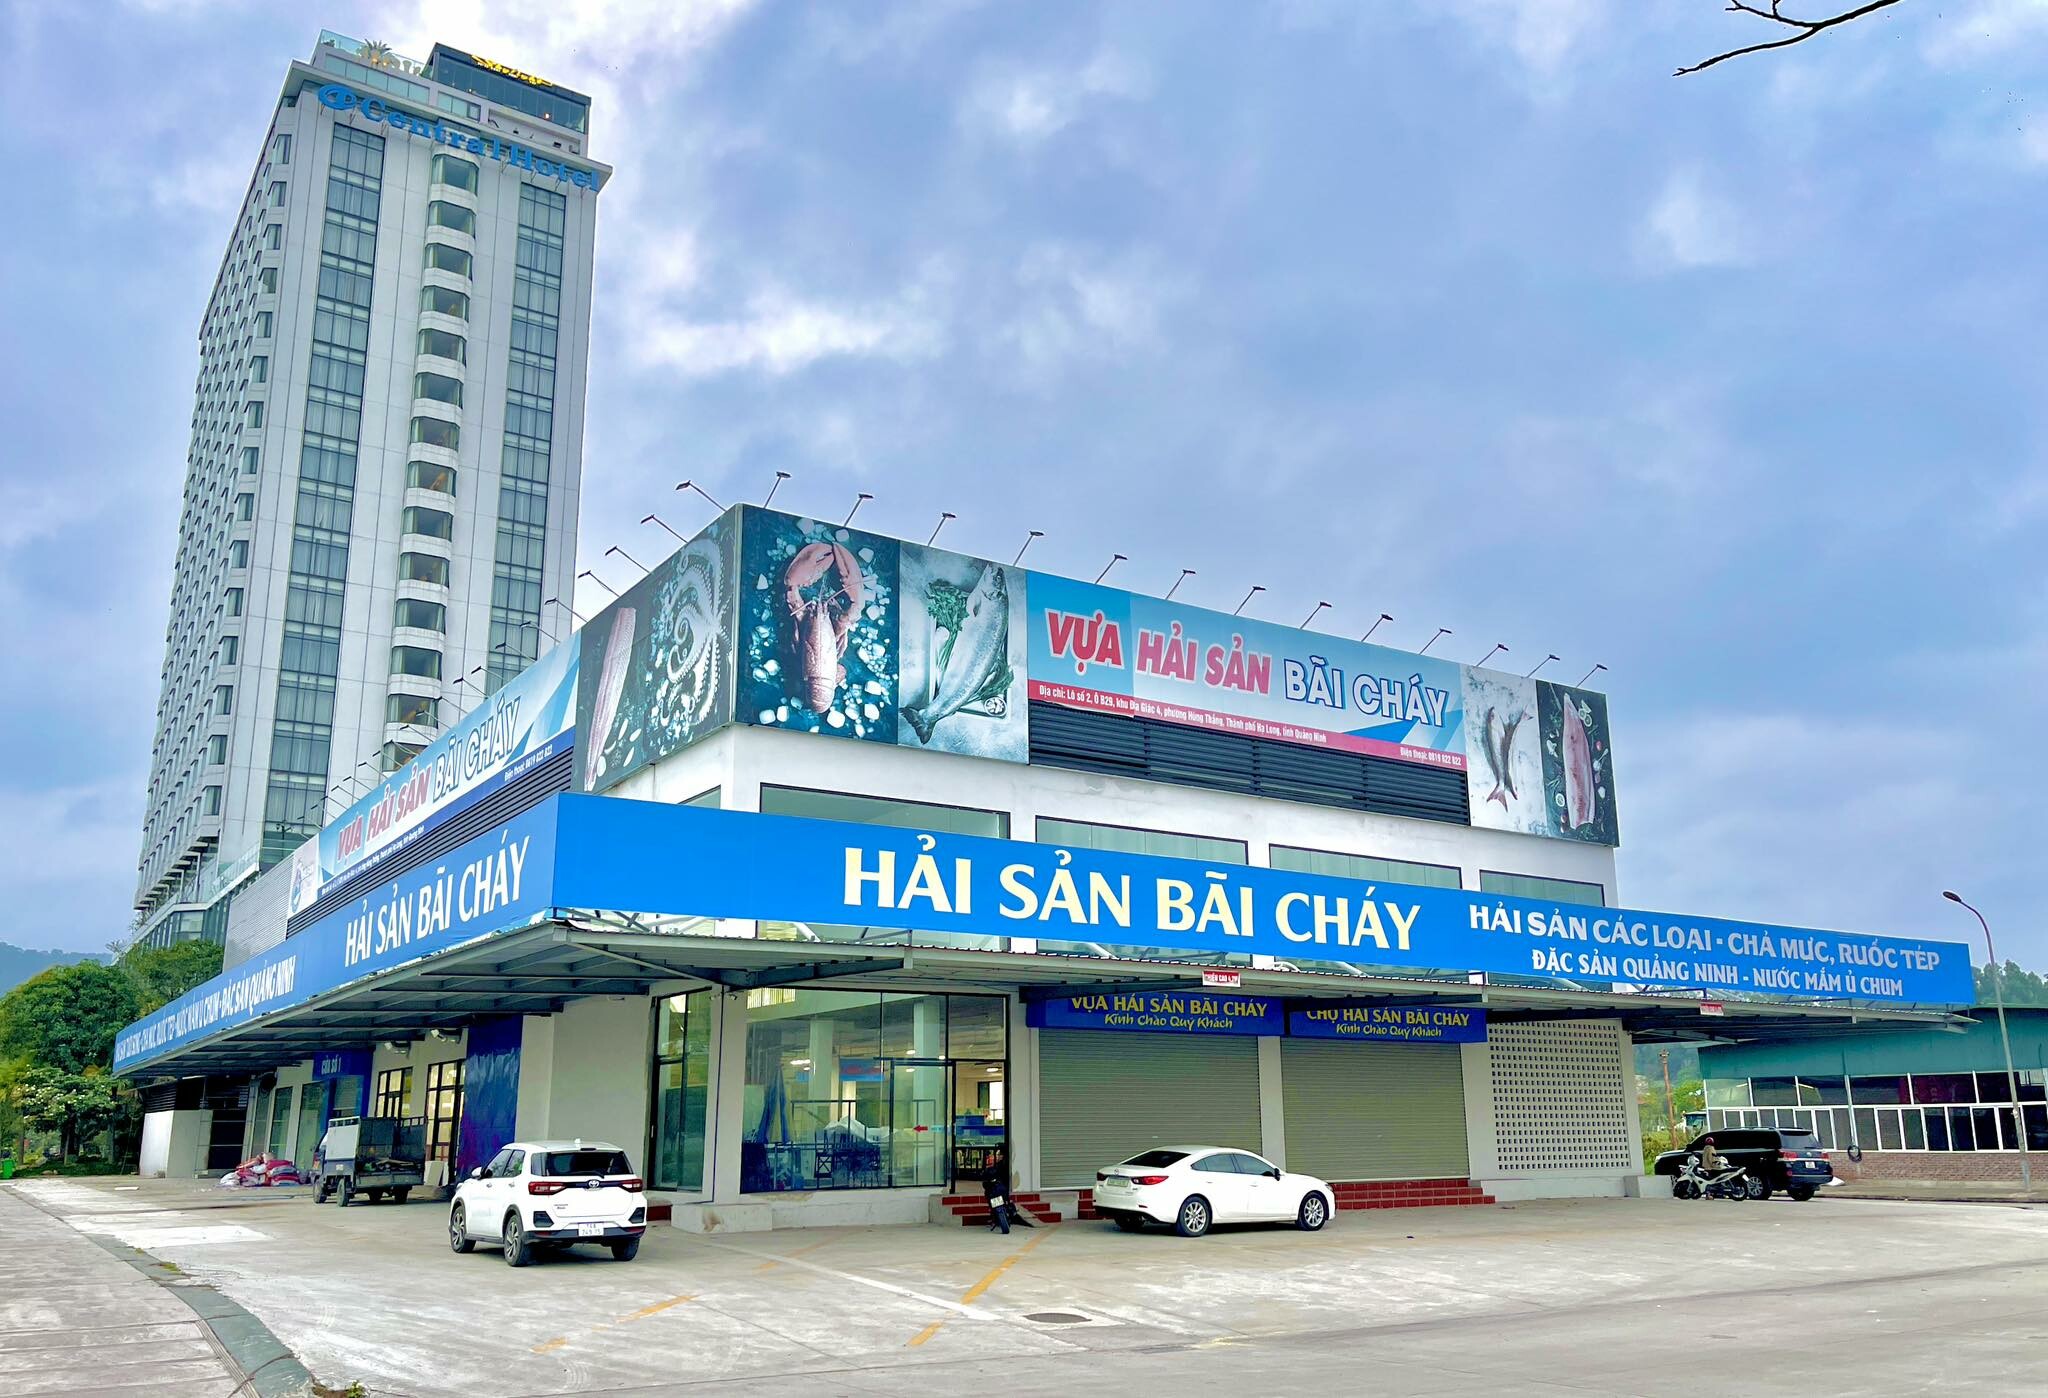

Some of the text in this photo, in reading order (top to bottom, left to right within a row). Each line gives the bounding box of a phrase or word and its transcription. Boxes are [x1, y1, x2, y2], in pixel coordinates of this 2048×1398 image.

[360, 96, 600, 192] Central Hotel
[1045, 608, 1449, 728] VỰA HẢI SẢN BÃI CHÁY
[1116, 698, 1128, 709] khu
[366, 784, 396, 842] HẢI
[395, 762, 433, 823] SẢN
[433, 733, 462, 803] BÃI
[464, 694, 521, 781] CHÁY
[344, 898, 373, 968] HẢI
[375, 882, 413, 955] SẢN
[416, 866, 454, 940] BÃI
[458, 829, 530, 923] CHÁY
[843, 834, 1421, 950] HẢI SẢN BÃI CHÁY
[1469, 901, 1522, 934] HẢI
[1527, 908, 1587, 941] SẢN
[1592, 914, 1648, 947] CÁC
[1653, 924, 1712, 955] LOẠI
[1727, 930, 1776, 959] CHẢ
[1781, 936, 1835, 966] MỰC,
[1838, 938, 1898, 969] RUỐC
[1900, 946, 1940, 971] TÉP
[1532, 947, 1573, 976] ĐẶC
[1578, 949, 1618, 977] SẢN
[1623, 953, 1689, 981] QUẢNG
[1694, 963, 1738, 985] NINH
[1753, 966, 1800, 990] NƯỚC
[1804, 967, 1841, 993] MẮM
[1846, 970, 1856, 993] Ủ
[1860, 976, 1903, 997] CHUM
[1137, 1013, 1167, 1026] Chào
[1169, 1015, 1195, 1031] Quý
[1197, 1015, 1233, 1029] Khách
[1150, 993, 1184, 1013] SẢN
[1190, 997, 1218, 1015] BÃI
[1223, 998, 1267, 1017] CHÁY
[1362, 1023, 1388, 1035] Chào
[1389, 1025, 1411, 1040] Quý
[1412, 1025, 1442, 1037] Khách
[1405, 1008, 1430, 1025] BÃI
[1433, 1009, 1470, 1027] CHÁY
